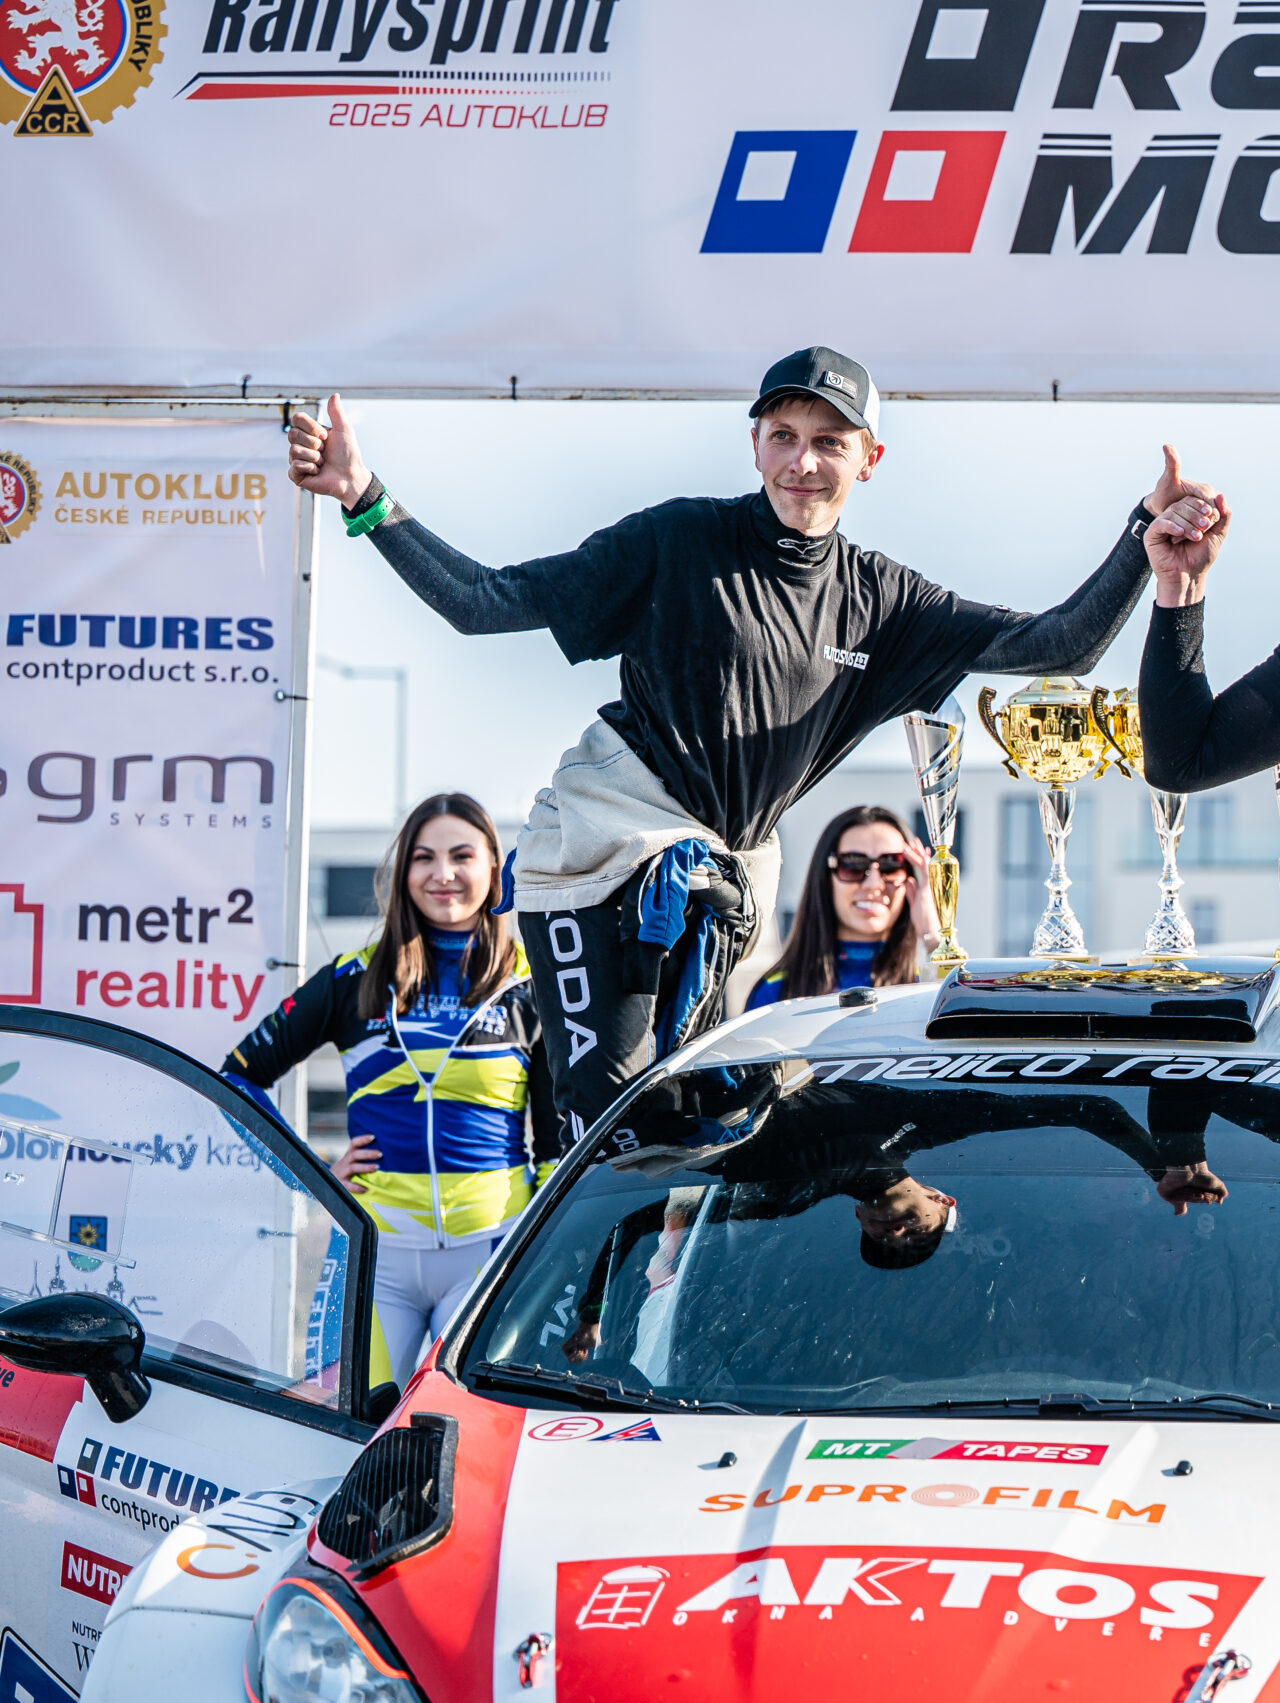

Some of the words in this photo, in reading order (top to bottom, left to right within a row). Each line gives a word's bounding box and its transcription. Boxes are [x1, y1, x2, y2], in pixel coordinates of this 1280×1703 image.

[25, 112, 81, 133] CCR
[329, 103, 411, 127] 2025
[420, 103, 608, 129] AUTOKLUB
[55, 472, 267, 500] AUTOKLUB
[54, 503, 130, 524] ČESKÉ
[142, 509, 266, 525] REPUBLIKY
[6, 614, 274, 651] FUTURES
[6, 657, 195, 686] contproduct
[204, 665, 279, 683] s.r.o.
[27, 752, 275, 824] grm
[109, 813, 272, 829] SYSTEMS
[76, 959, 265, 1022] reality
[548, 916, 598, 1069] ODA
[781, 1054, 1091, 1088] melico
[823, 1443, 892, 1456] MT
[963, 1443, 1091, 1461] TAPES
[67, 1554, 128, 1596] NUTR
[676, 1557, 1220, 1629] AKTOS
[672, 1605, 833, 1626] OKNA
